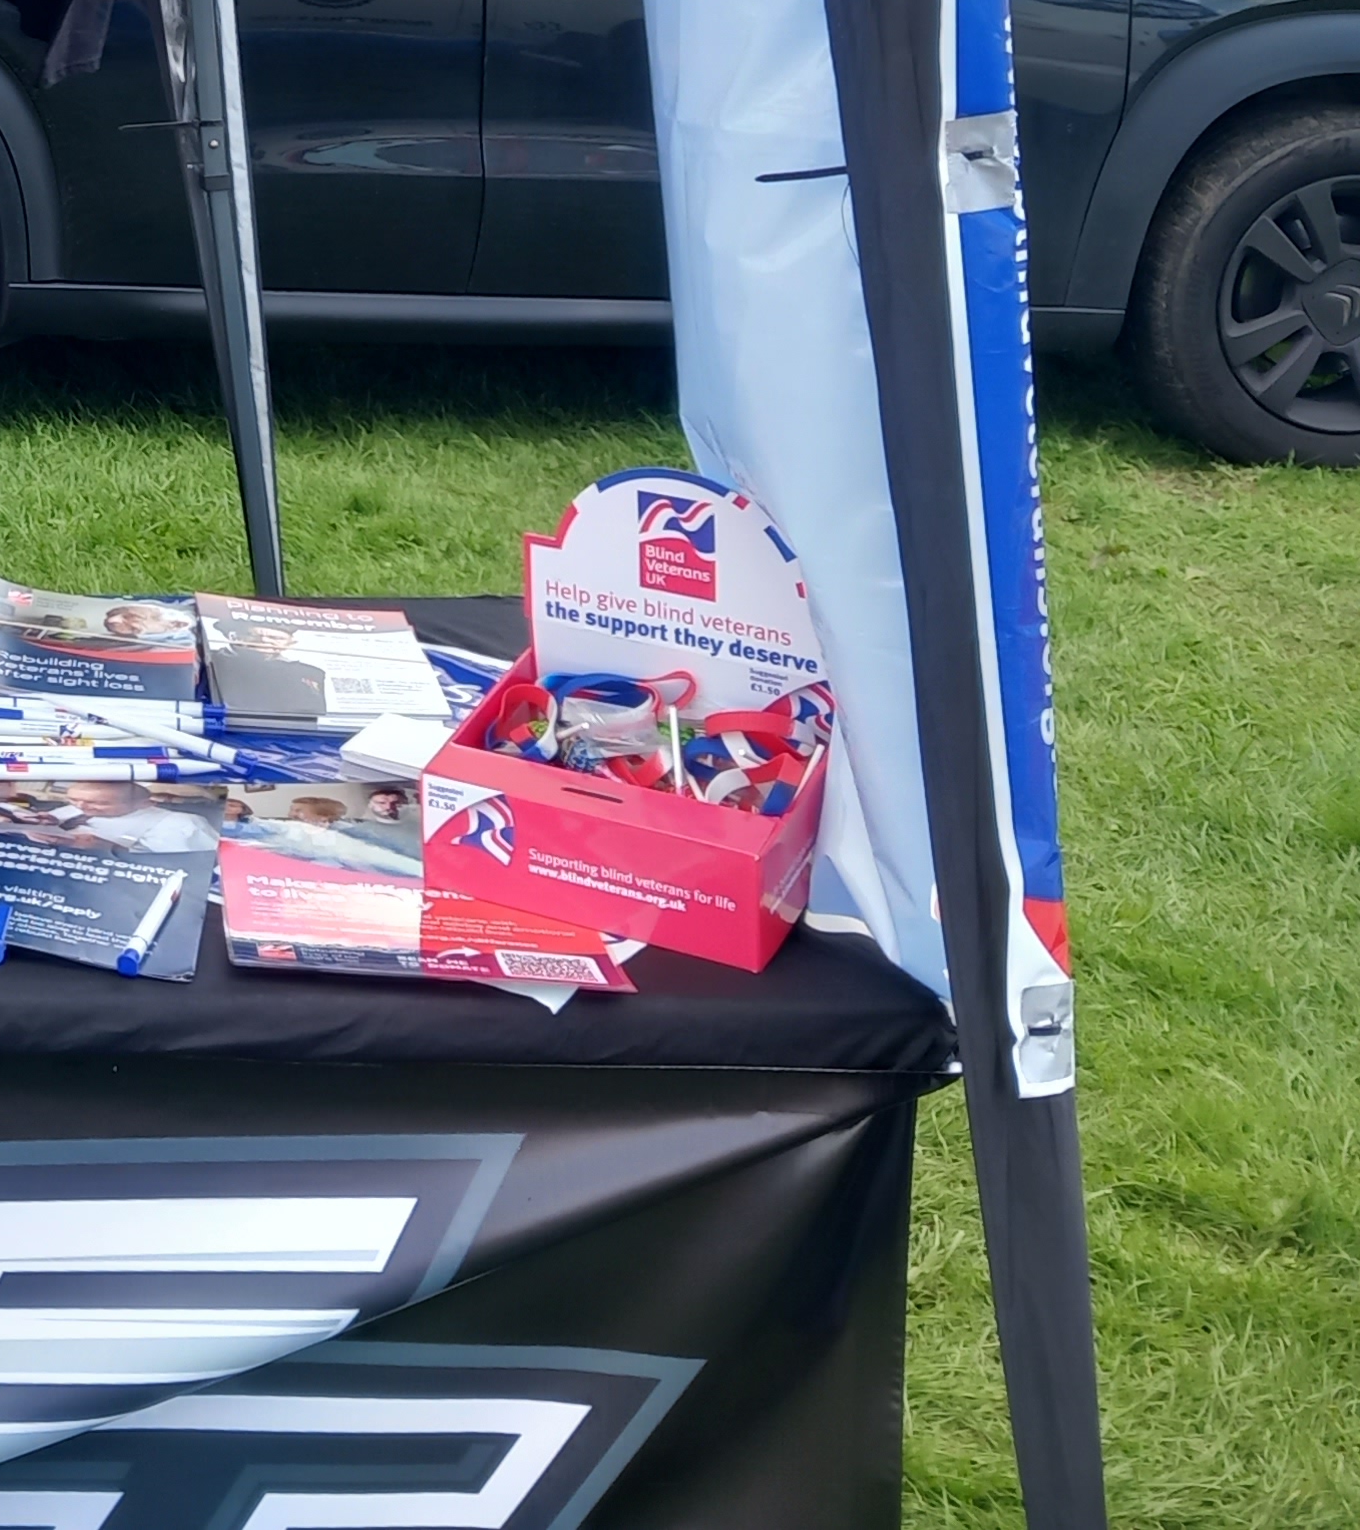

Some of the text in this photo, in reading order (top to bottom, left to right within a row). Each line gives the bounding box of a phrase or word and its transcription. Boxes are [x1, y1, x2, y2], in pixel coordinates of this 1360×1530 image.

[645, 543, 686, 565] Blind
[645, 558, 712, 584] Veterans
[645, 571, 668, 588] UK
[226, 599, 375, 622] Planning to
[545, 578, 793, 646] Help give blind veterans
[231, 610, 376, 633] Remember
[545, 599, 819, 675] the support they deserve
[46, 673, 100, 688] sight
[102, 678, 145, 693] loss
[93, 670, 141, 683] lives
[750, 682, 781, 697] £1.50
[428, 798, 456, 812] £1.50
[61, 851, 98, 864] our
[69, 871, 109, 885] our
[246, 874, 317, 890] Make
[527, 846, 738, 914] Supporting blind veterans for life
[527, 862, 687, 913] www.blindveterans.org.uk
[4, 884, 67, 905] visiting
[247, 886, 279, 898] to
